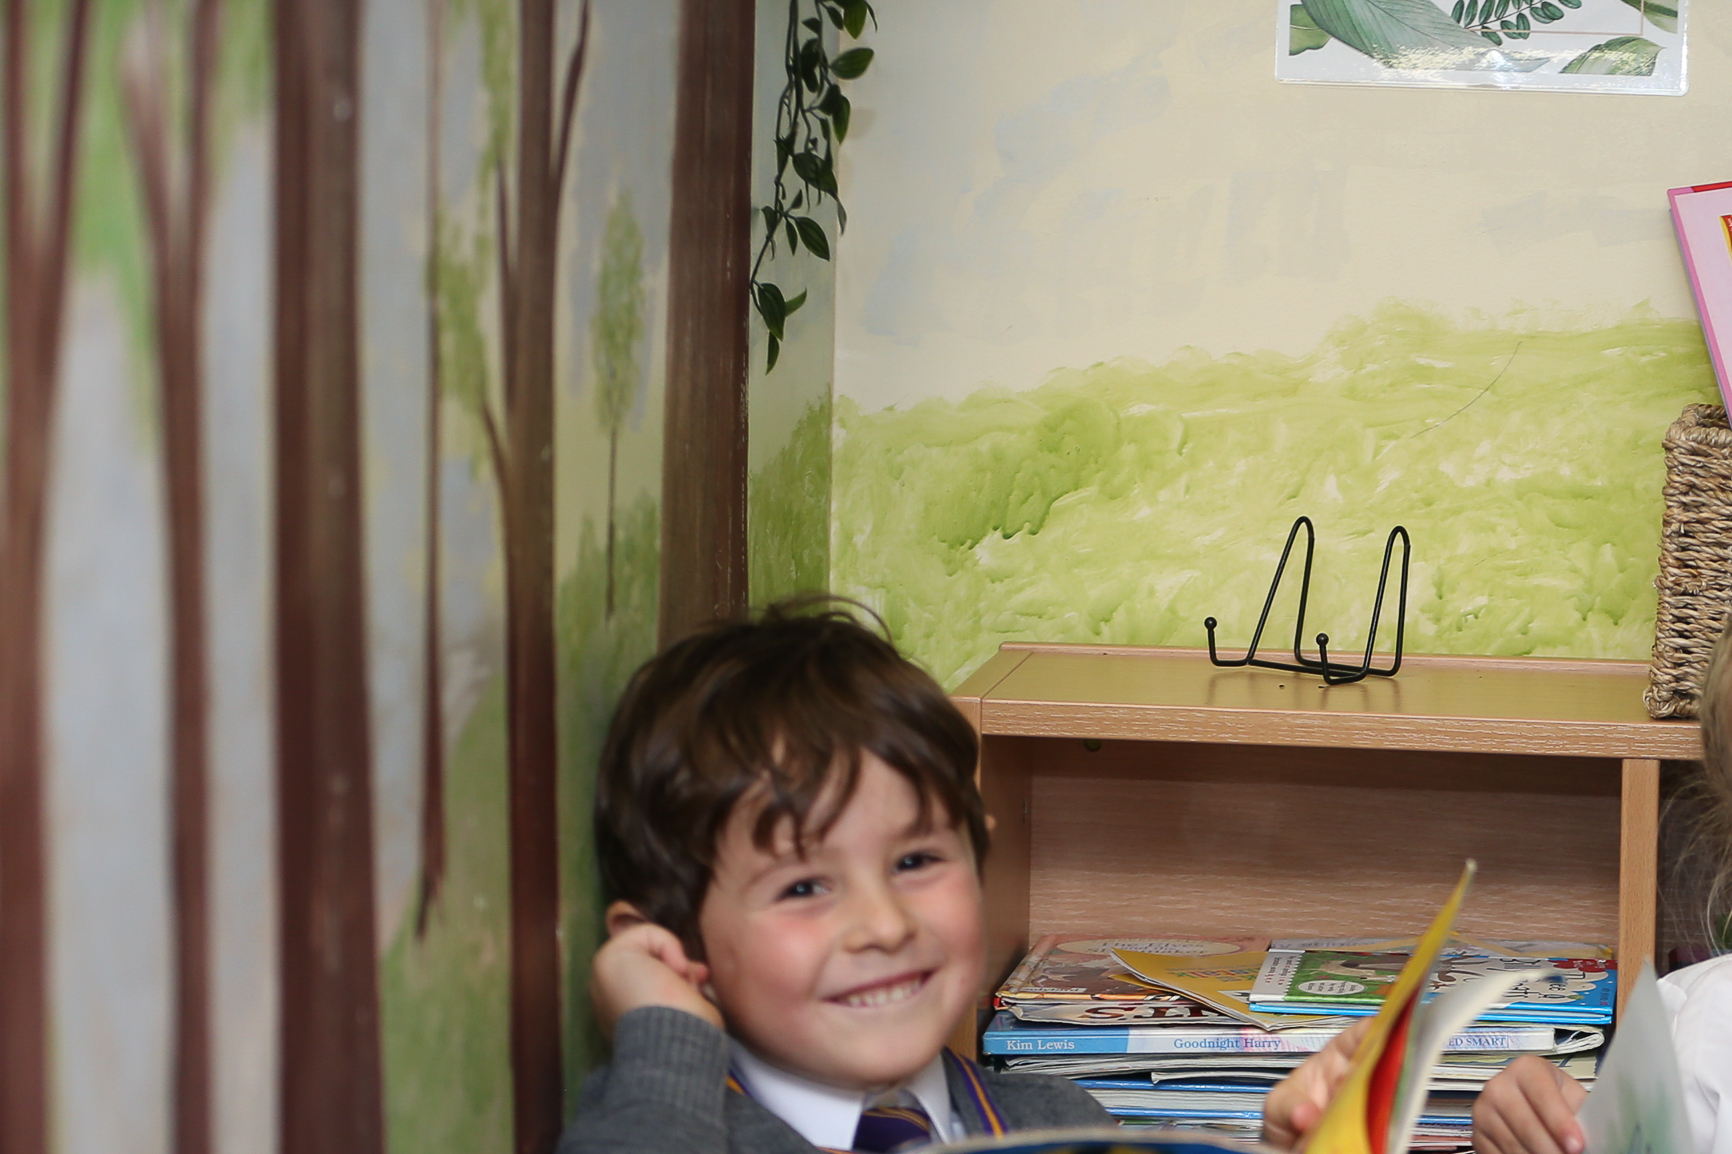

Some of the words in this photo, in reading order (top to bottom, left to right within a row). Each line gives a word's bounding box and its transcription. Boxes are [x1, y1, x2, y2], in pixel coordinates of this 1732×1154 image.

[1006, 1039, 1034, 1050] Kim
[1037, 1039, 1075, 1050] Lewis
[1174, 1038, 1240, 1051] Goodnight
[1243, 1038, 1281, 1052] Harry
[1466, 1037, 1506, 1046] SMART
